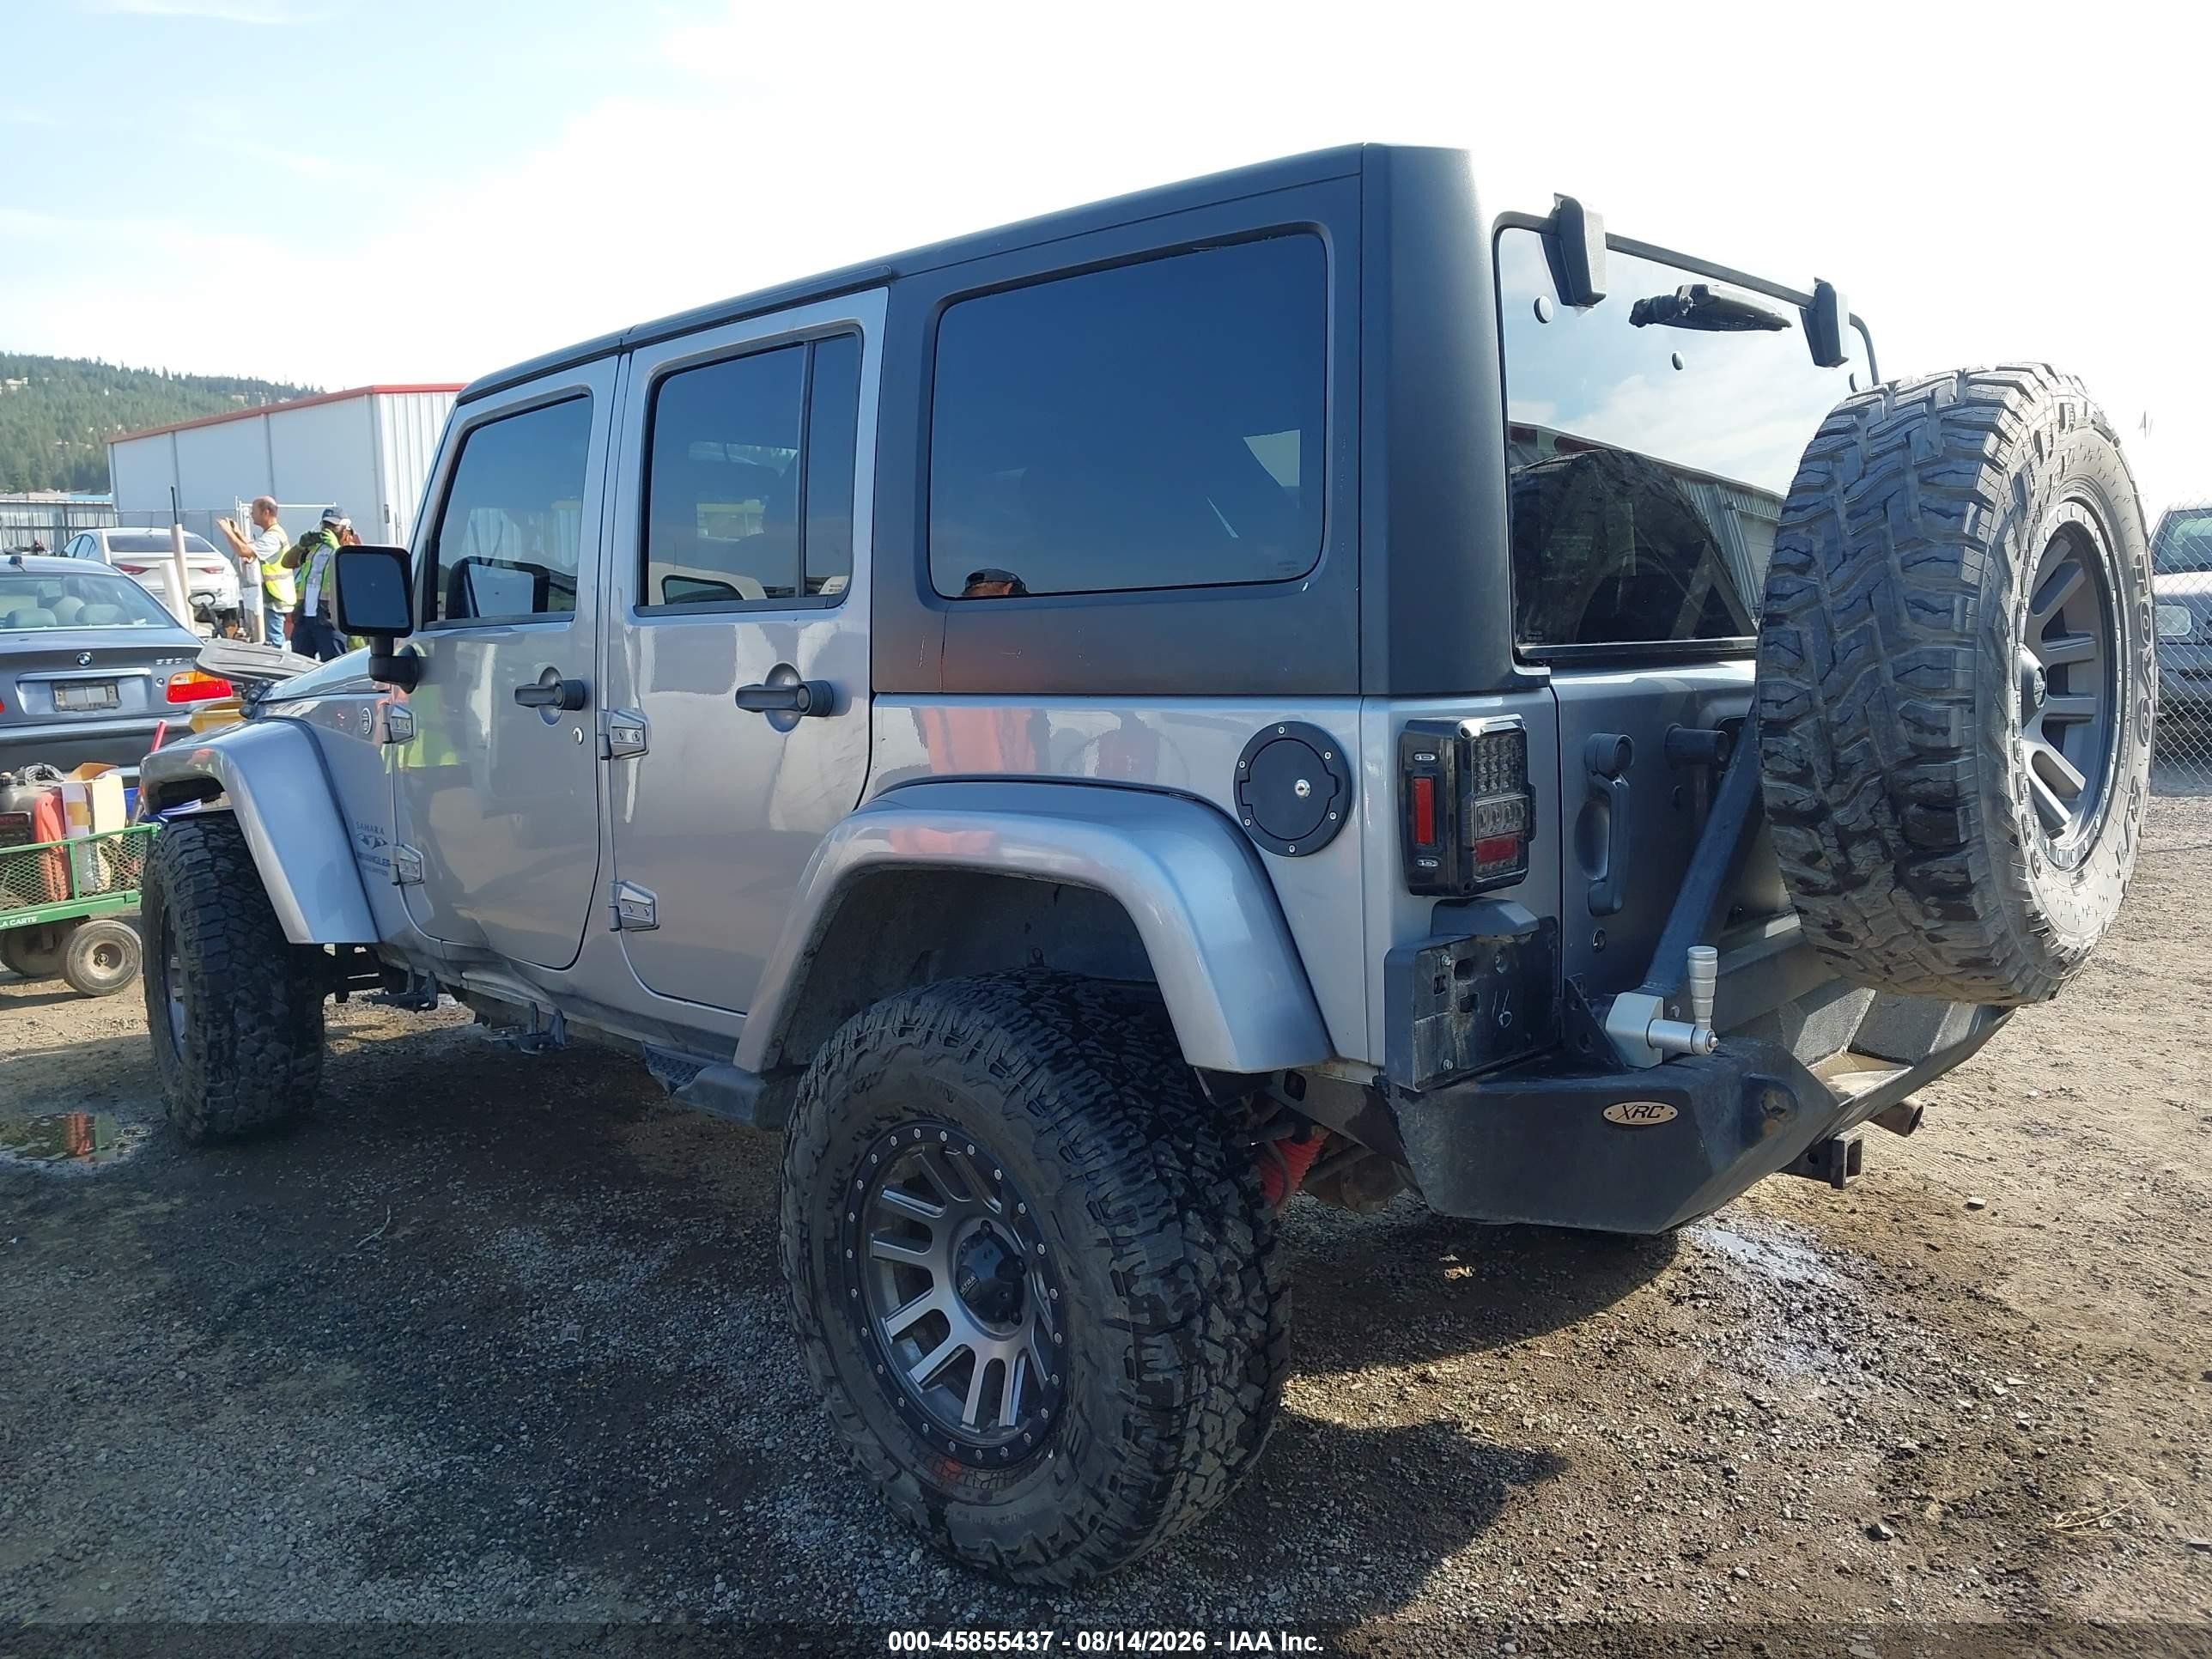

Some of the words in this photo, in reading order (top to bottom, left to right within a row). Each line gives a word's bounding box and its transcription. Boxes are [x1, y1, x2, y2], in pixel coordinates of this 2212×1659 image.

[2133, 554, 2153, 748] TOYO
[356, 821, 385, 836] SAHARA
[9, 916, 38, 927] CARTS
[1492, 988, 1513, 1029] 16
[1615, 1104, 1665, 1120] XRC
[959, 1275, 977, 1293] ULTRA
